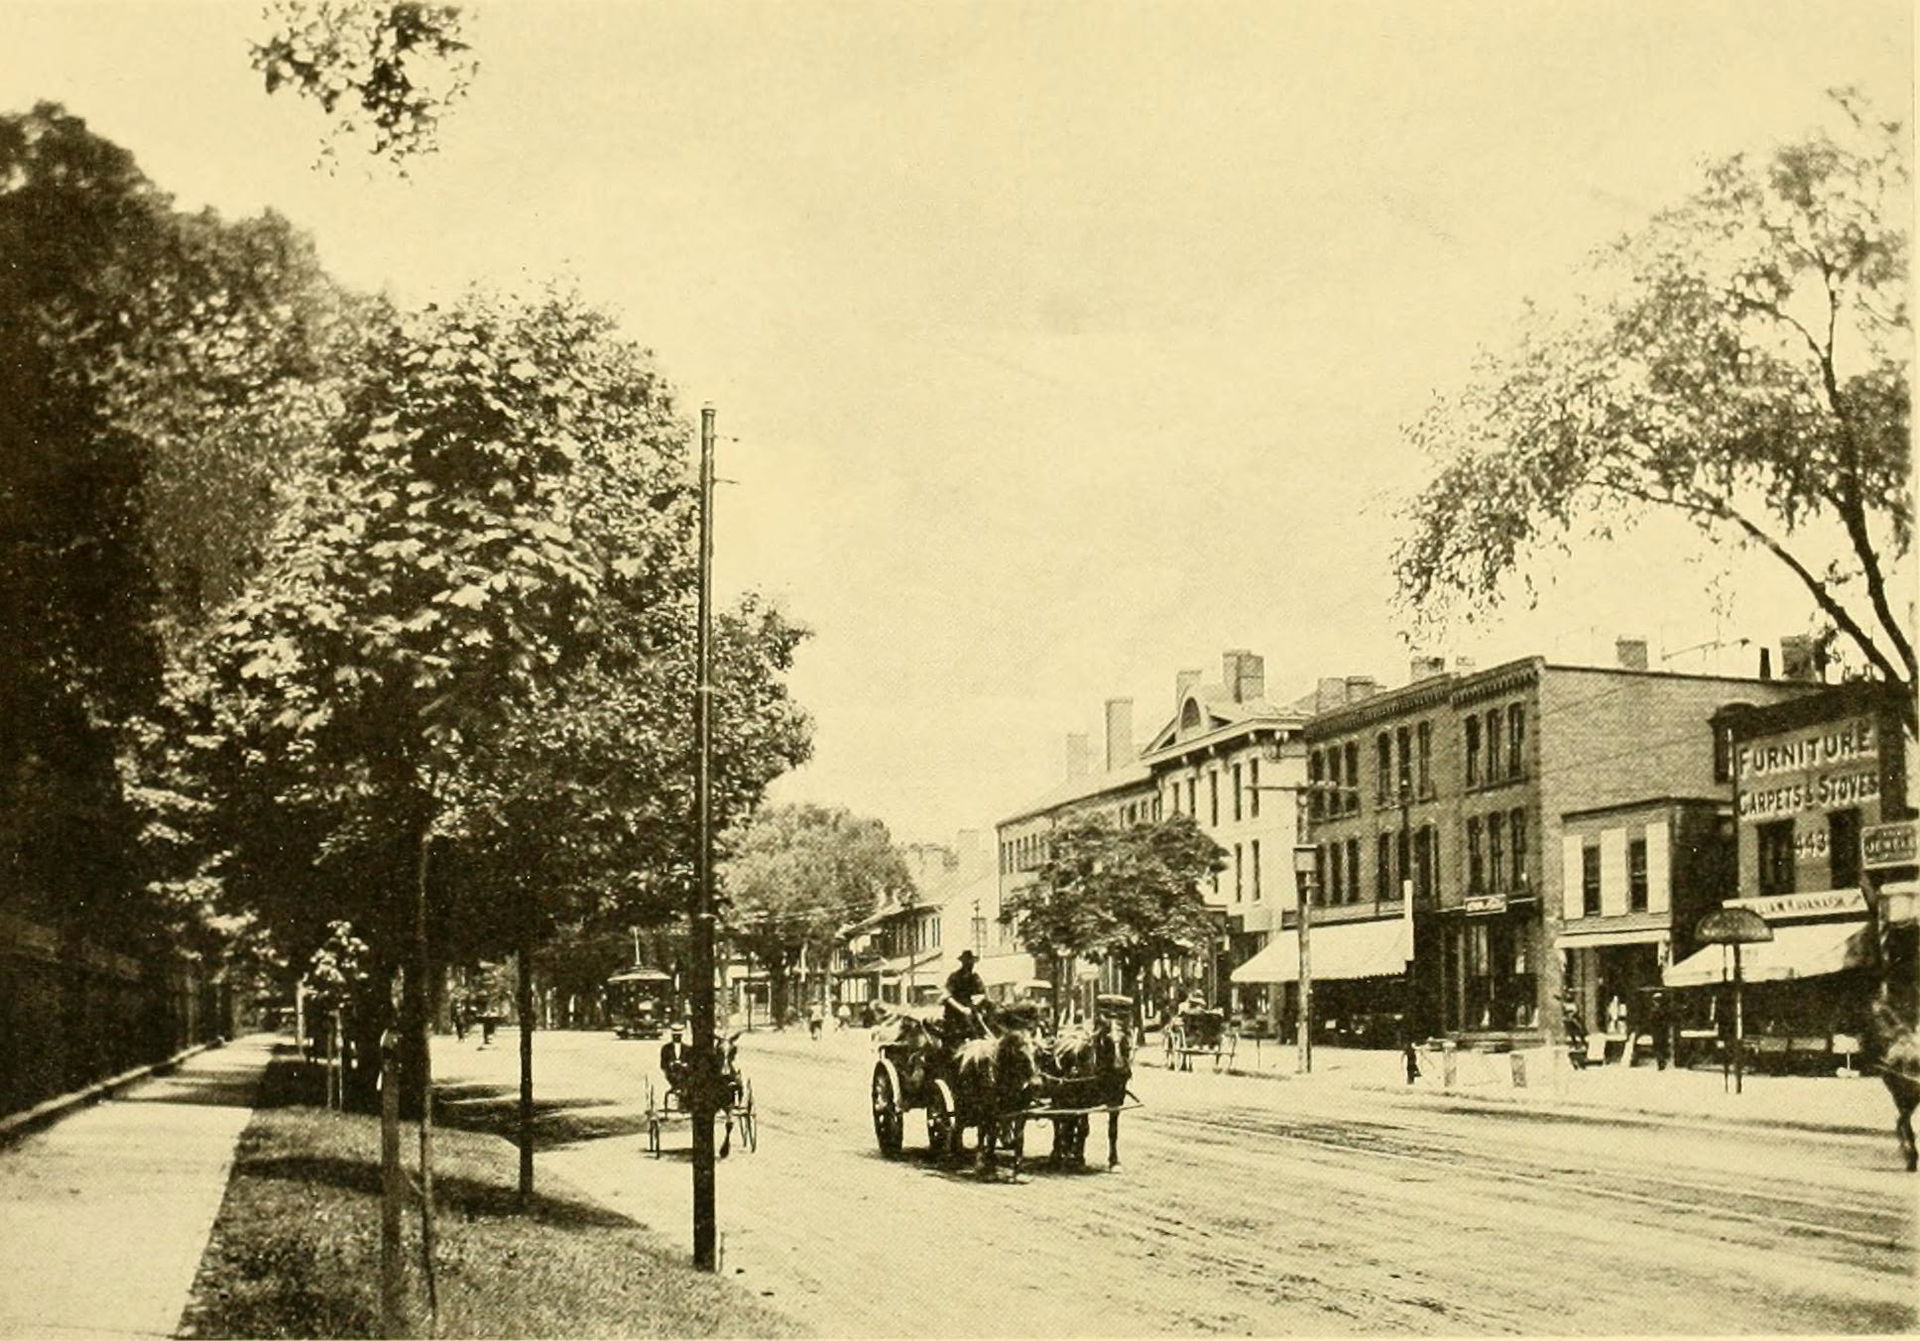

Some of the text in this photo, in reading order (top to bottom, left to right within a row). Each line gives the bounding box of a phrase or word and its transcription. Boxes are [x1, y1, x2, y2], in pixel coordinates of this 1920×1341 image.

[1739, 721, 1877, 777] FURNITURE
[1738, 784, 1803, 816] CARPETS
[1818, 772, 1879, 806] STOVES
